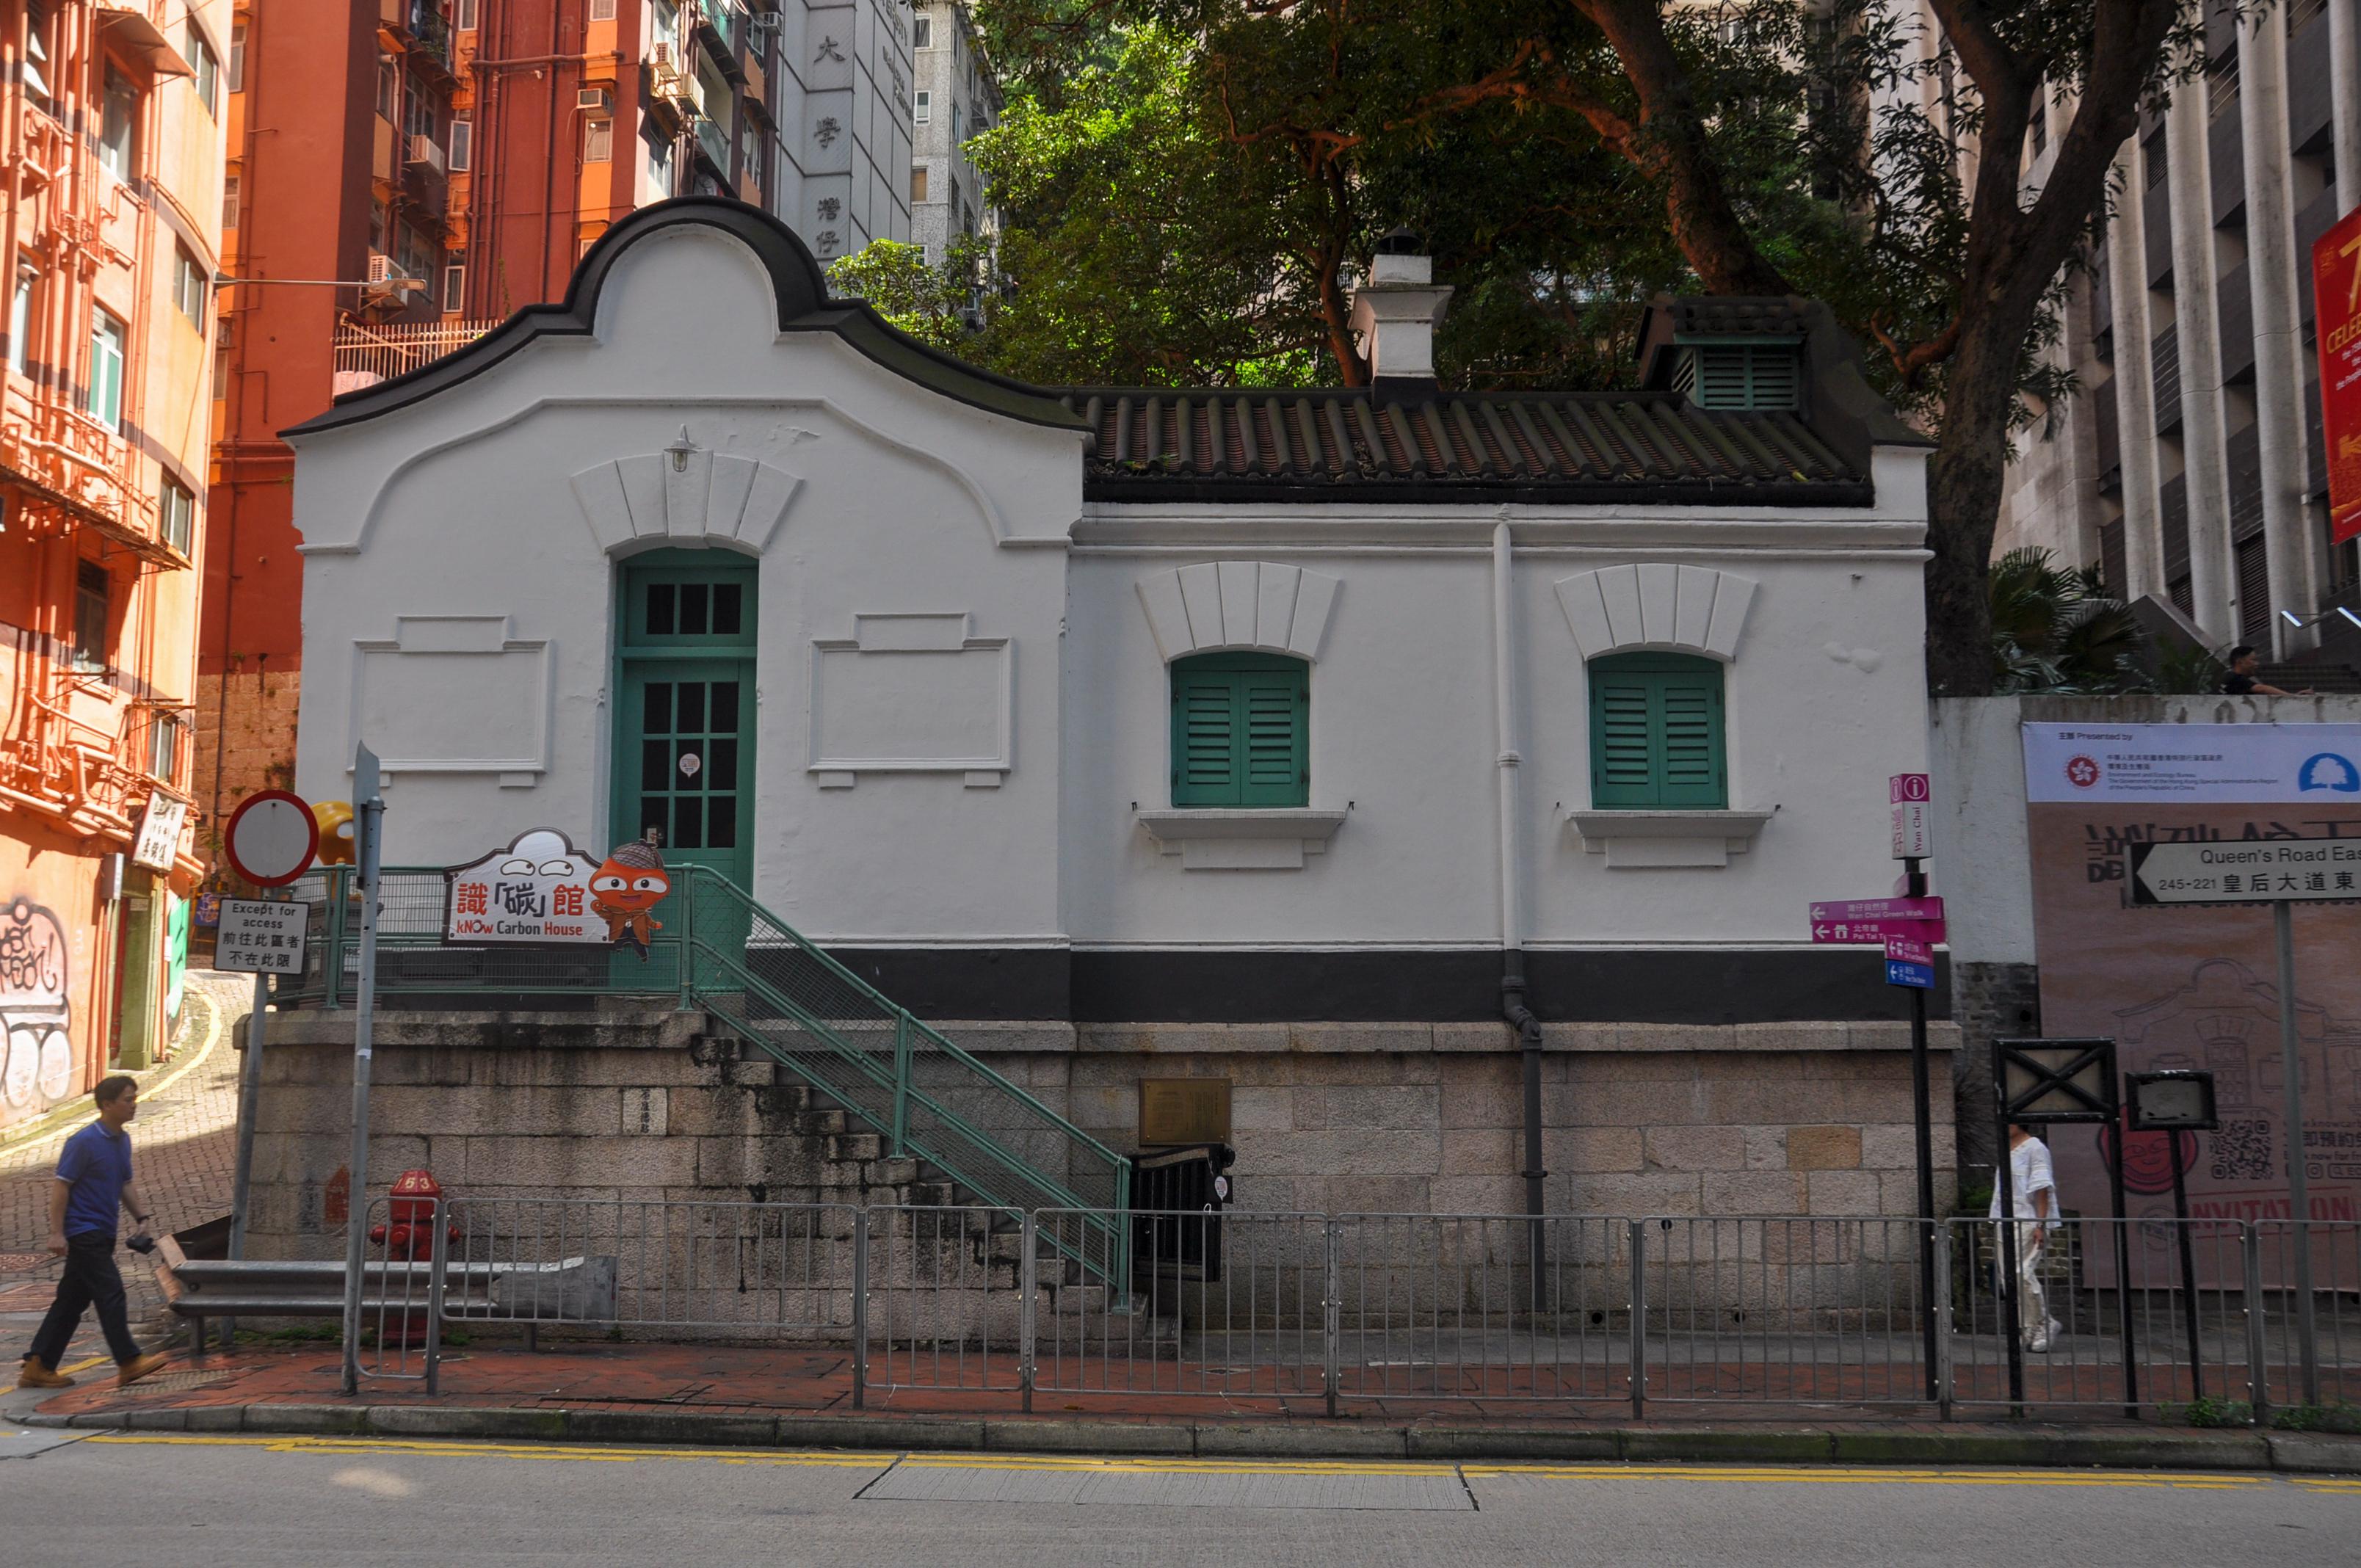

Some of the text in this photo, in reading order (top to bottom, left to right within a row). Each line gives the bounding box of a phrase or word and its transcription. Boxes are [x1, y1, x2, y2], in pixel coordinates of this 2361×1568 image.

[2076, 732, 2120, 741] Presented
[2122, 733, 2133, 742] by
[1912, 807, 1922, 852] Wan Chai
[2200, 849, 2272, 865] Queen's
[2278, 846, 2326, 863] Road
[2158, 871, 2355, 893] 245-221 皇后大道東
[457, 882, 585, 918] 識「碳」館
[233, 902, 274, 918] Except
[280, 907, 297, 918] for
[243, 920, 283, 930] access
[497, 920, 541, 936] Carbon
[544, 921, 584, 937] House
[222, 932, 300, 950] 前往此區者
[229, 951, 291, 968] 不在此限
[2190, 1197, 2353, 1230] NVITATON
